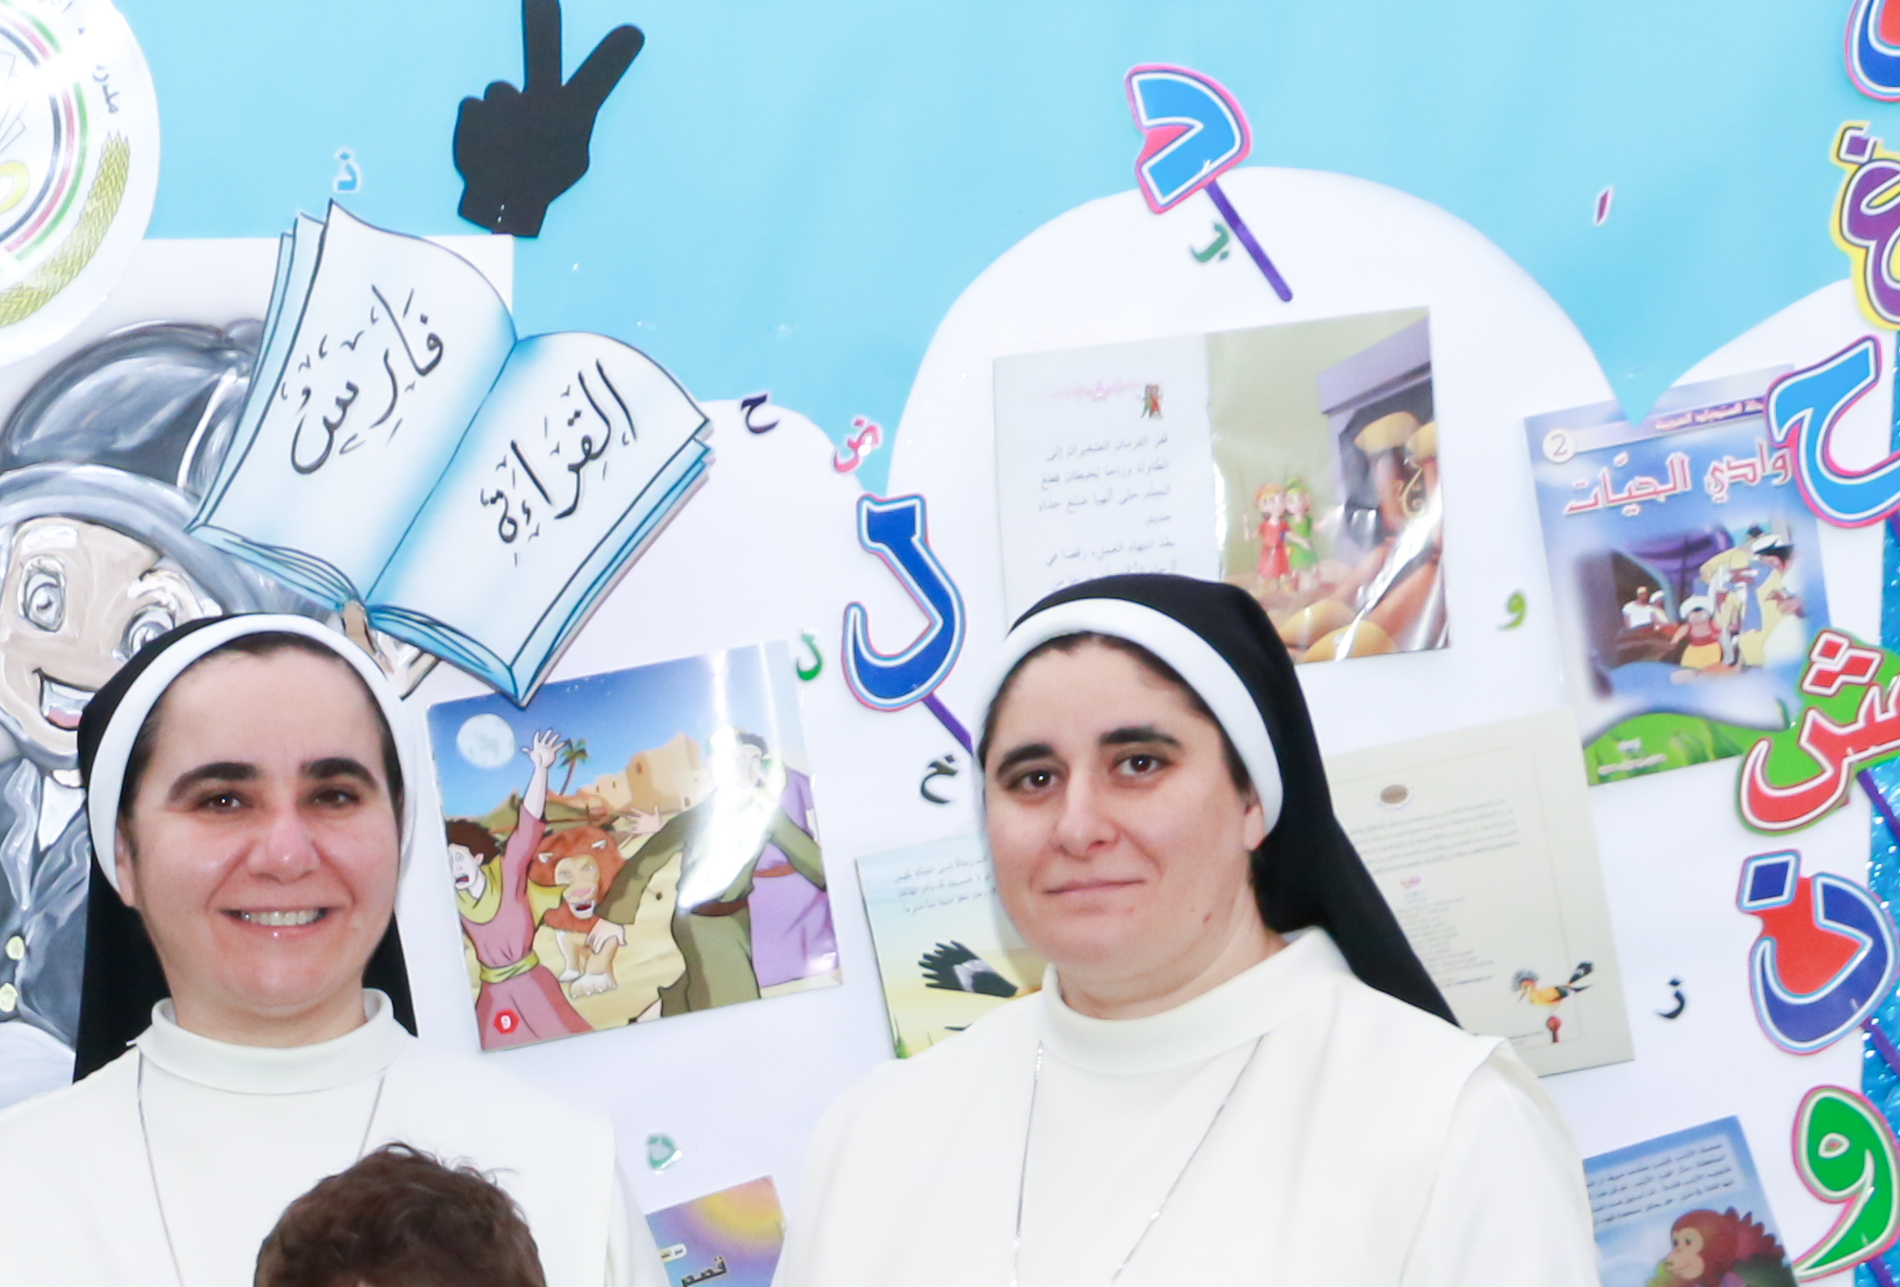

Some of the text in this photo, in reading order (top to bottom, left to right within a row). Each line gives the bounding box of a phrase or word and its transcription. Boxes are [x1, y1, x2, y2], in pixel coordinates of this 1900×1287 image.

[1125, 63, 1253, 214] د
[741, 393, 780, 434] ح
[1548, 433, 1570, 458] 2
[1704, 437, 1793, 503] وادي
[842, 493, 965, 712] ل
[1498, 590, 1527, 629] و
[920, 754, 958, 805] خ
[1656, 978, 1685, 1019] ز
